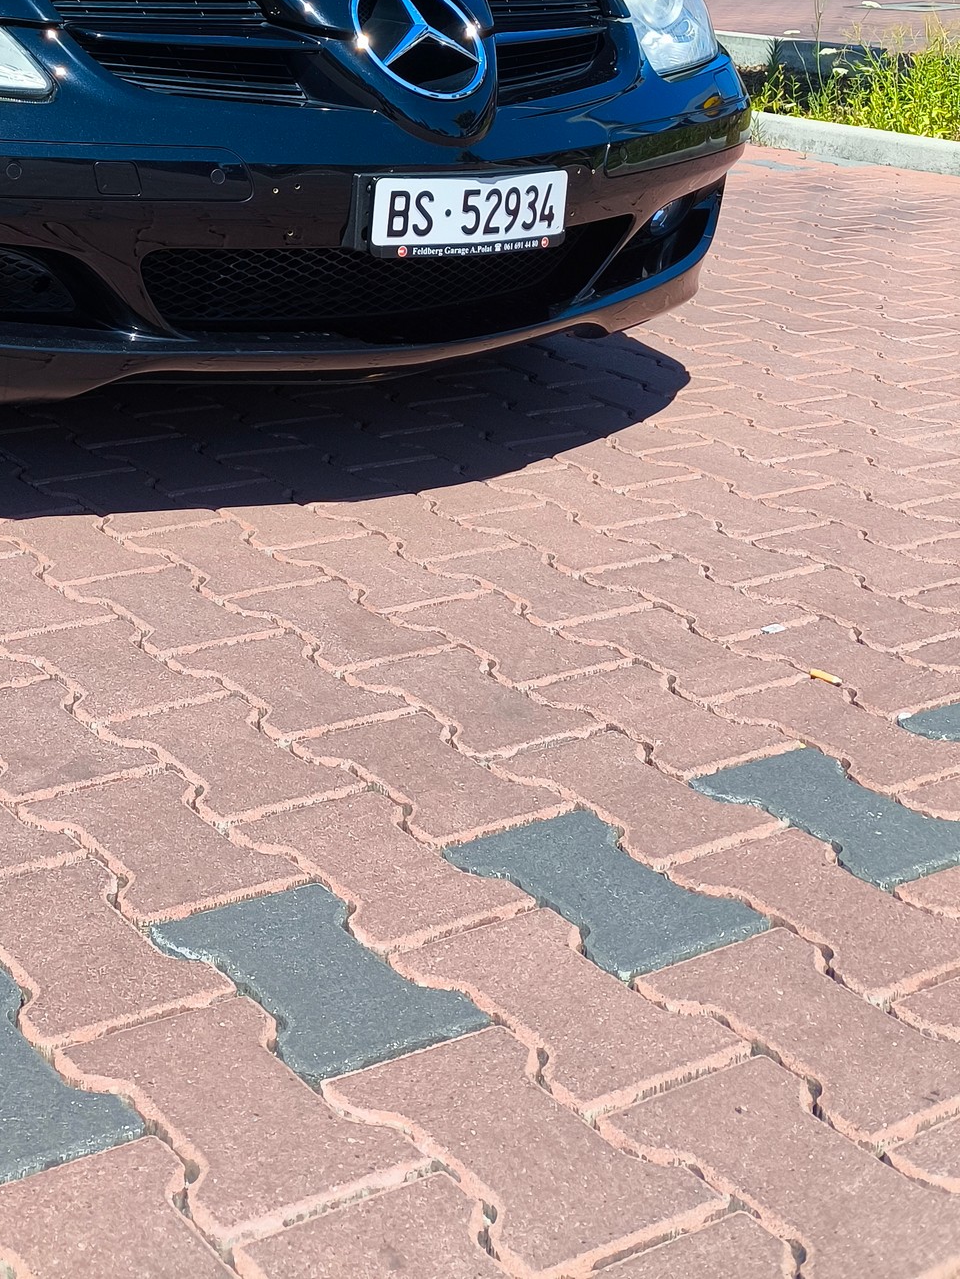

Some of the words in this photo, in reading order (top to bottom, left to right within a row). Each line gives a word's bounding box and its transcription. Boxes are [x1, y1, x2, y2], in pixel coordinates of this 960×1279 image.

[412, 246, 443, 256] Feldberg
[444, 245, 469, 255] Garage
[504, 242, 513, 251] 061
[514, 241, 523, 250] 691
